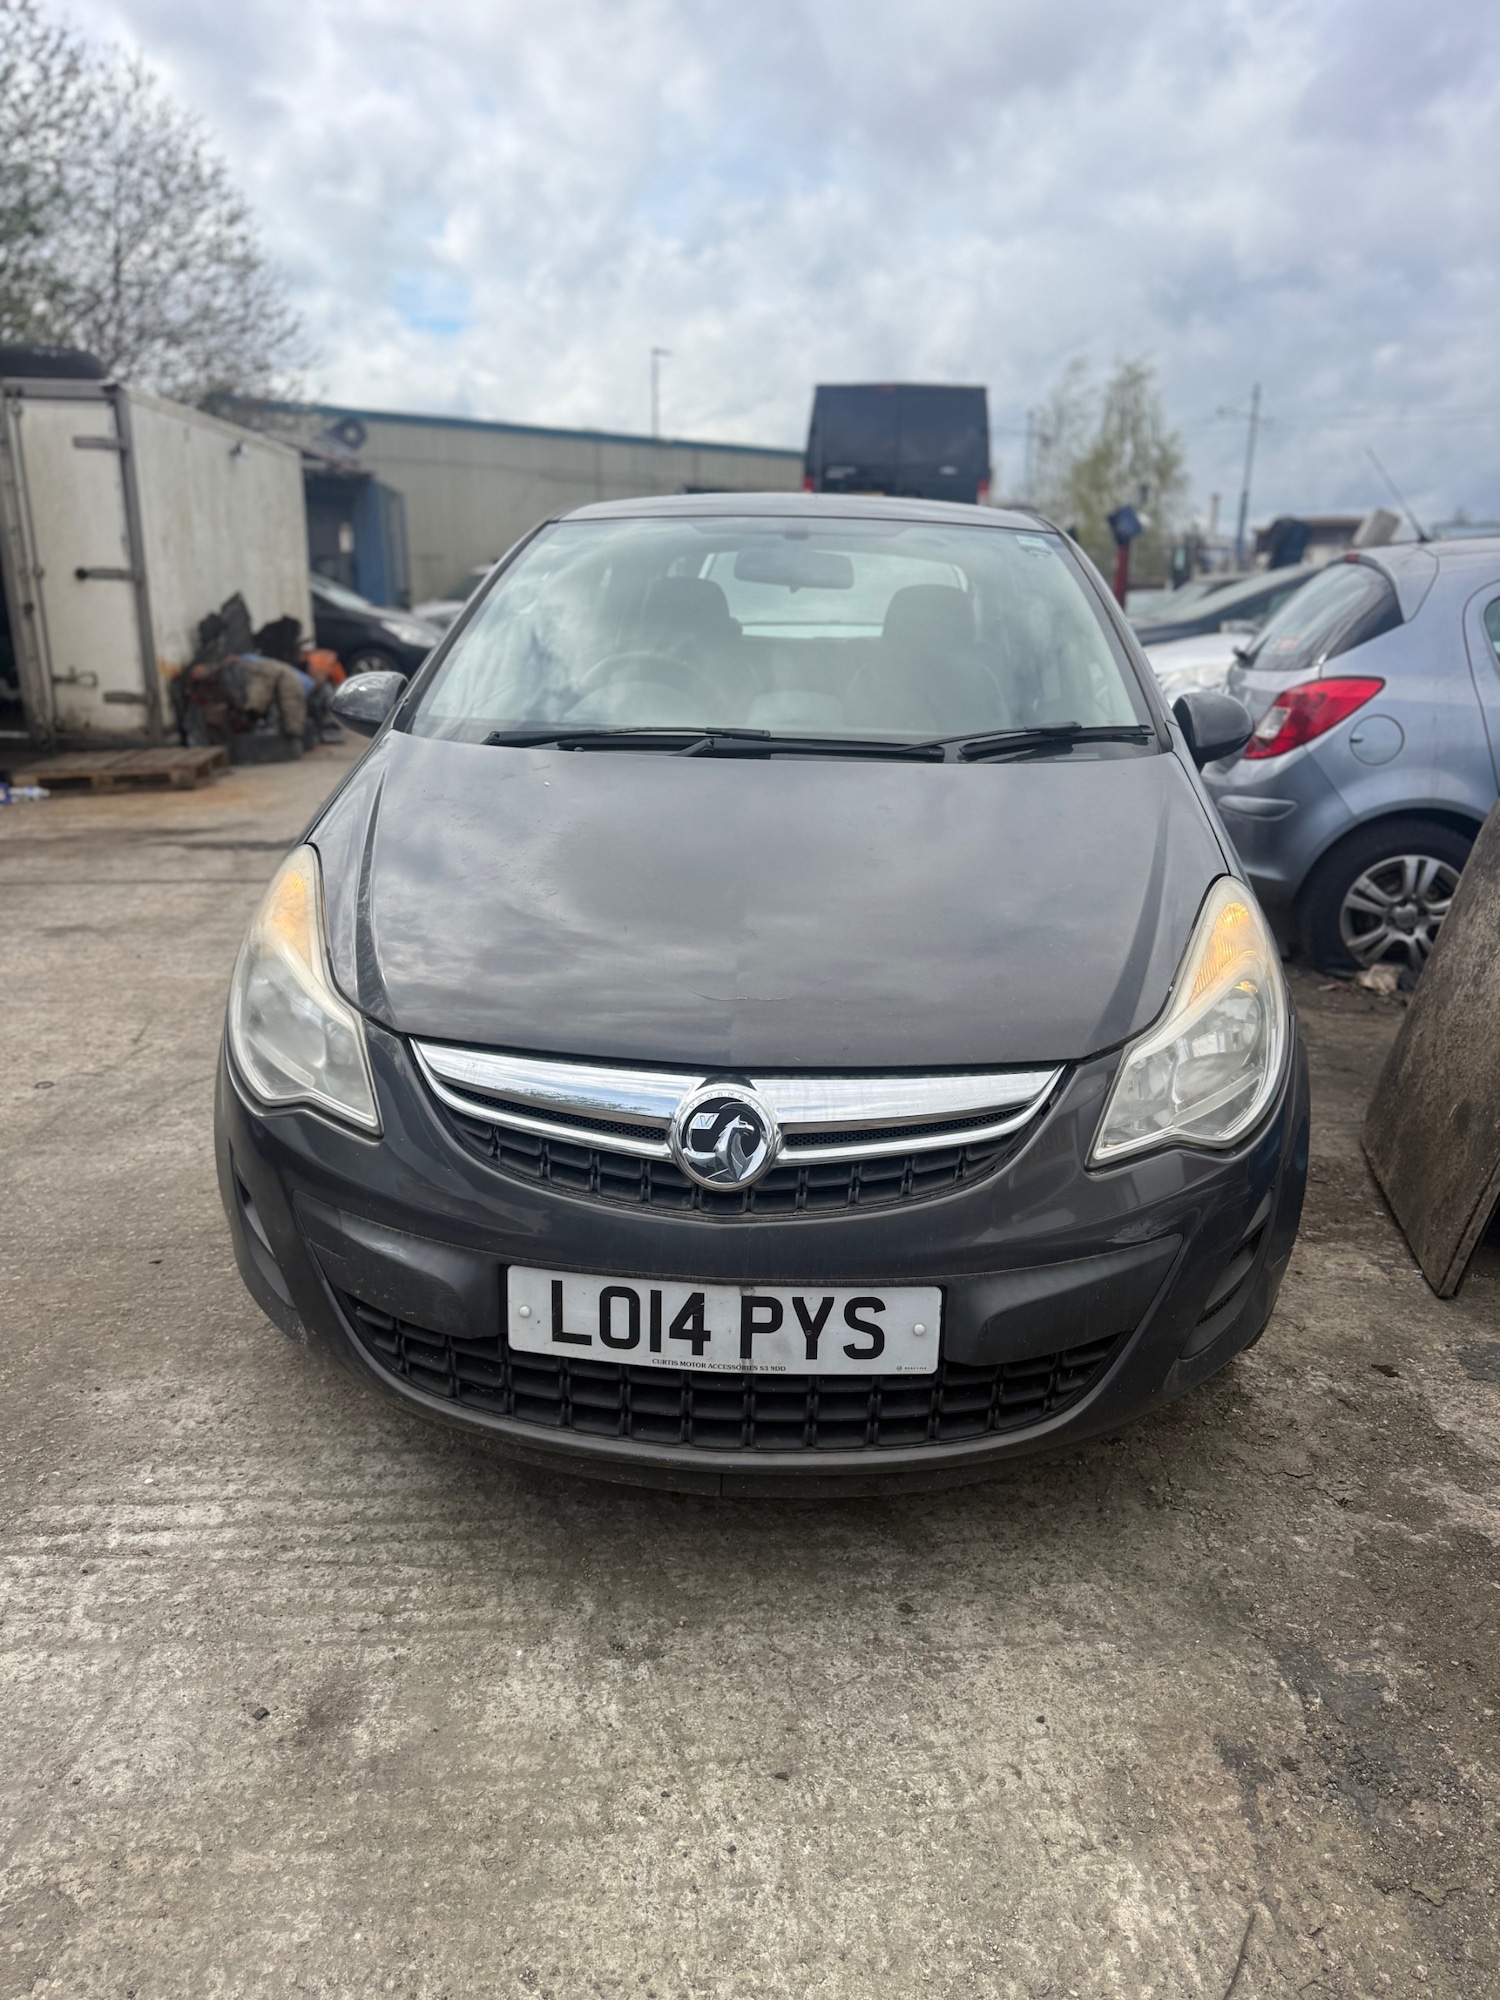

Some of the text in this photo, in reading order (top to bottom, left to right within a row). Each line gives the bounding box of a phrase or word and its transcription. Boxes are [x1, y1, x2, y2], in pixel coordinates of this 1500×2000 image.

[689, 1091, 762, 1115] VAUXHALL
[551, 1280, 886, 1360] LO14 PYS
[652, 1358, 678, 1366] CURTIS
[707, 1363, 758, 1371] ACCESSORIES
